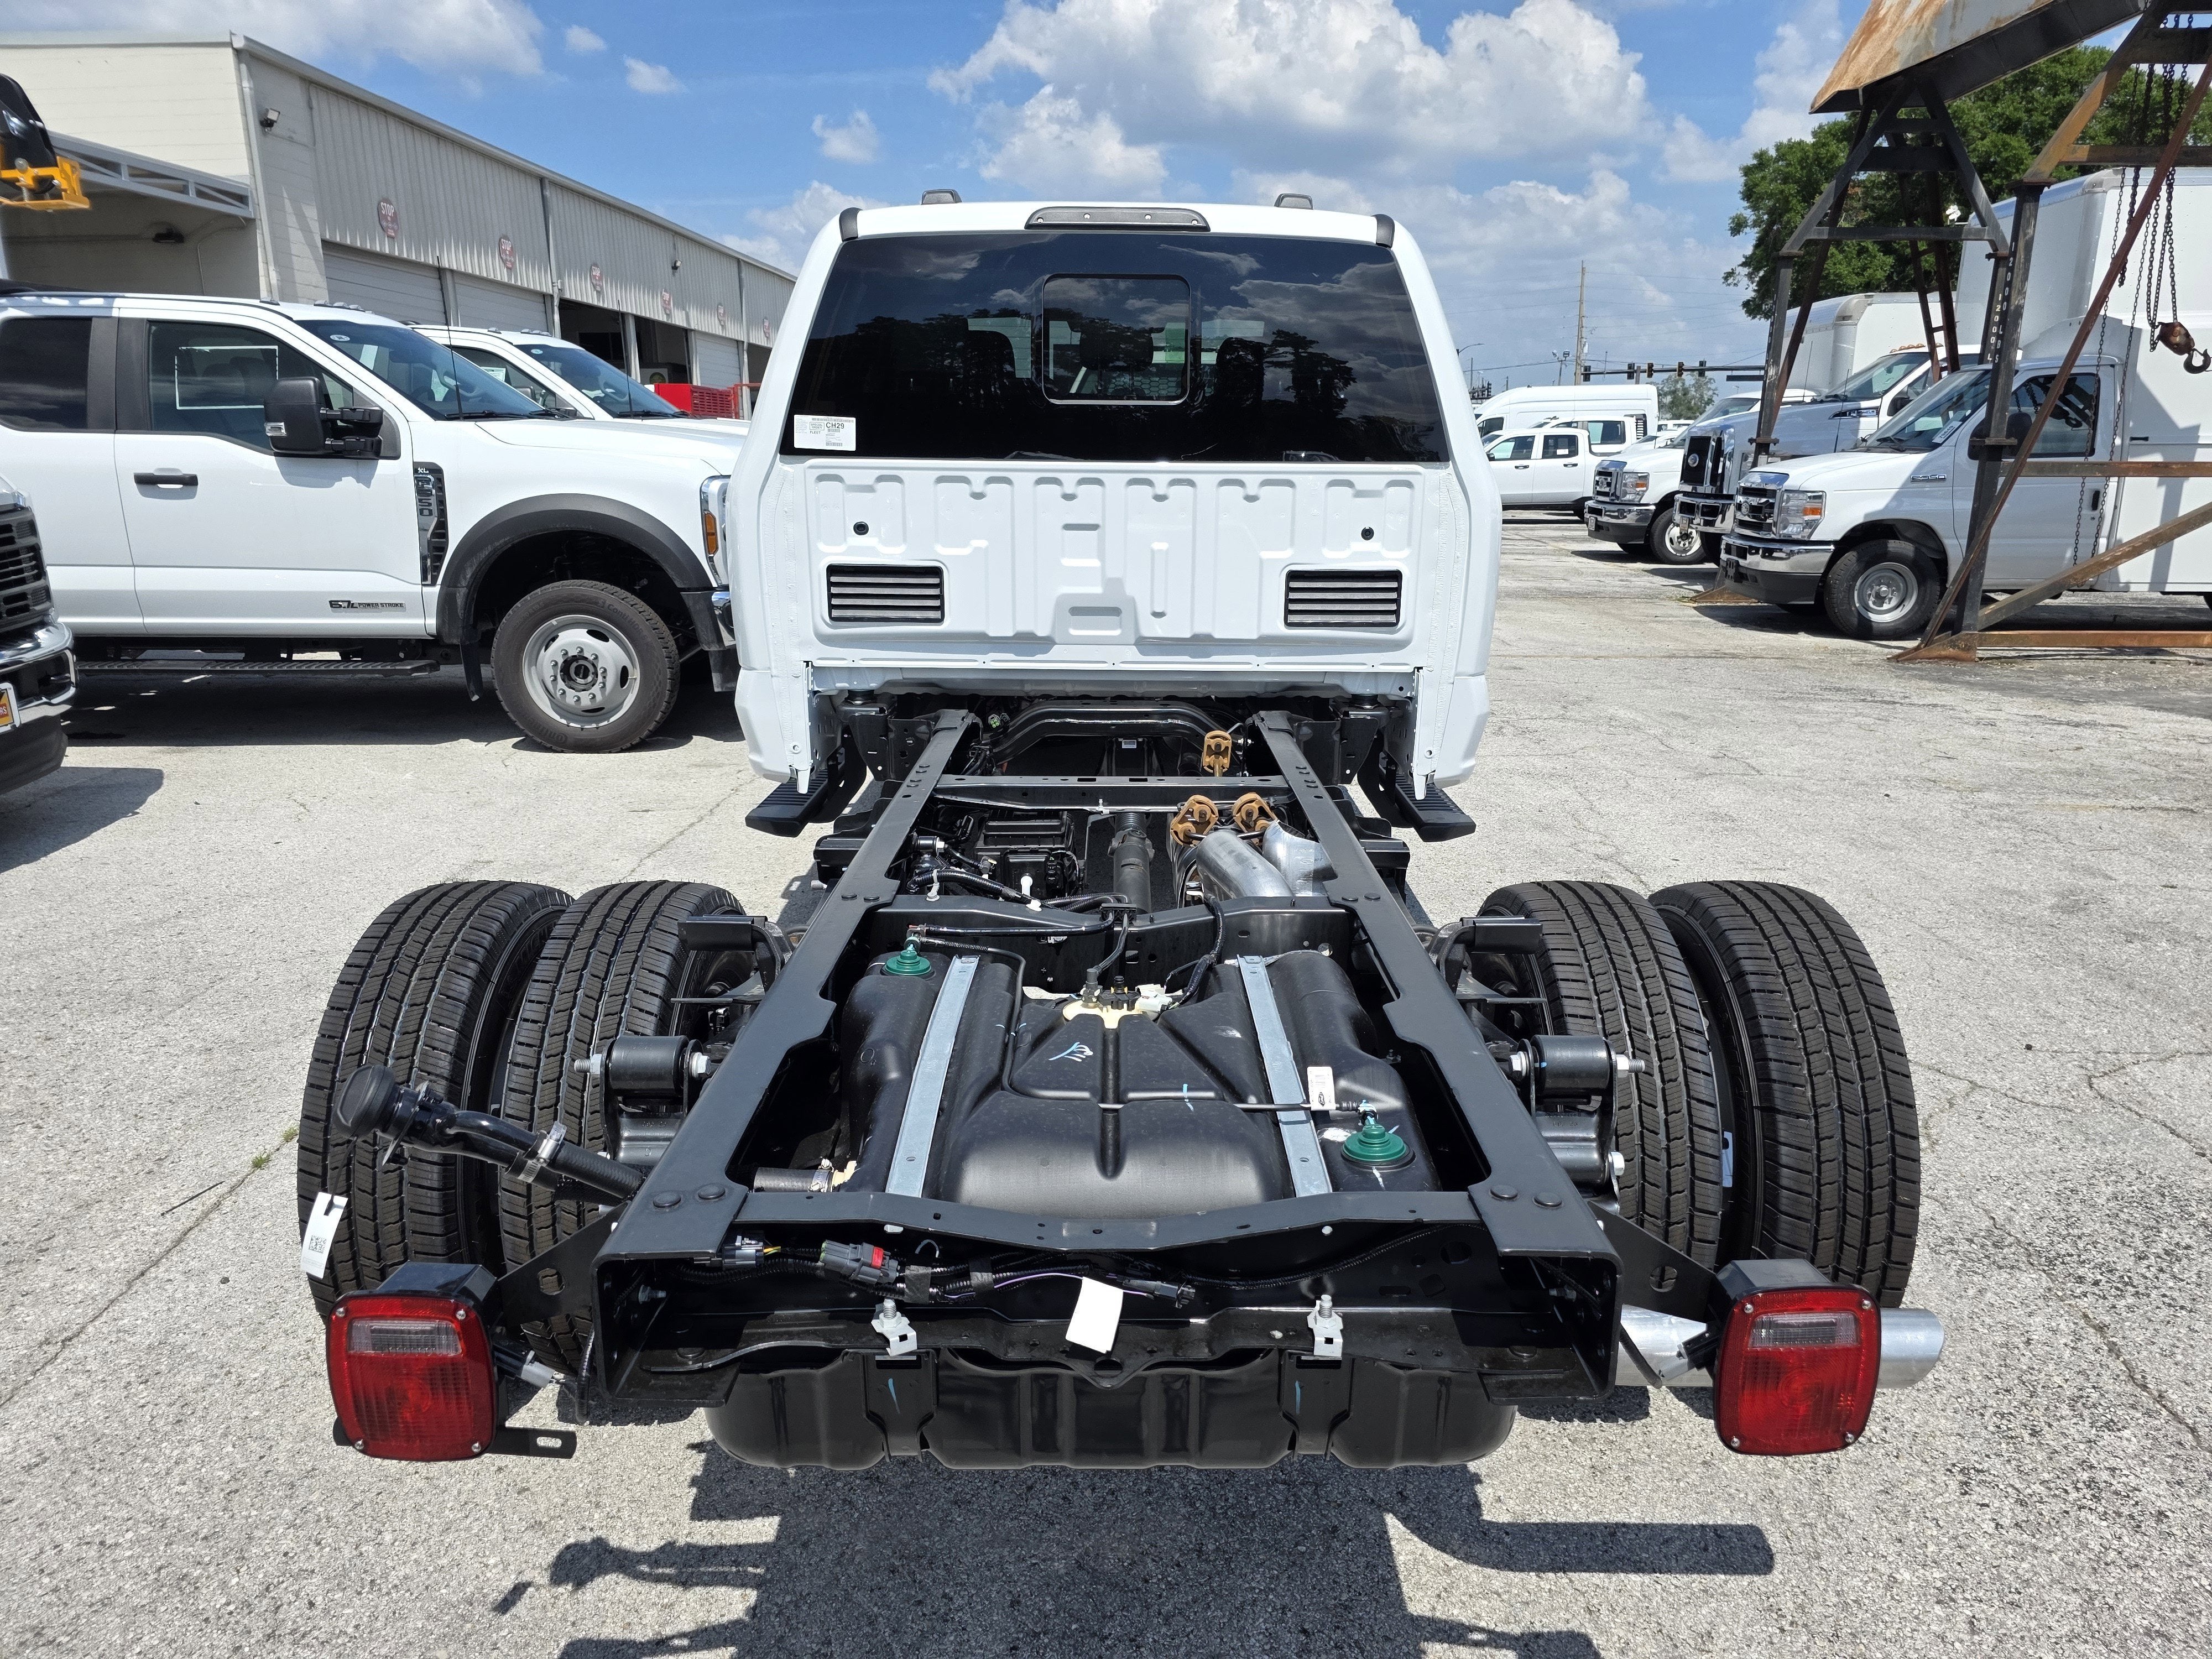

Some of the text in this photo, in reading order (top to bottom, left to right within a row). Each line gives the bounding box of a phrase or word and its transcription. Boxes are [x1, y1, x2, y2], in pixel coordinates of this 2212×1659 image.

[380, 201, 395, 217] STOP
[501, 238, 512, 251] STOP
[328, 600, 358, 609] 6.7L
